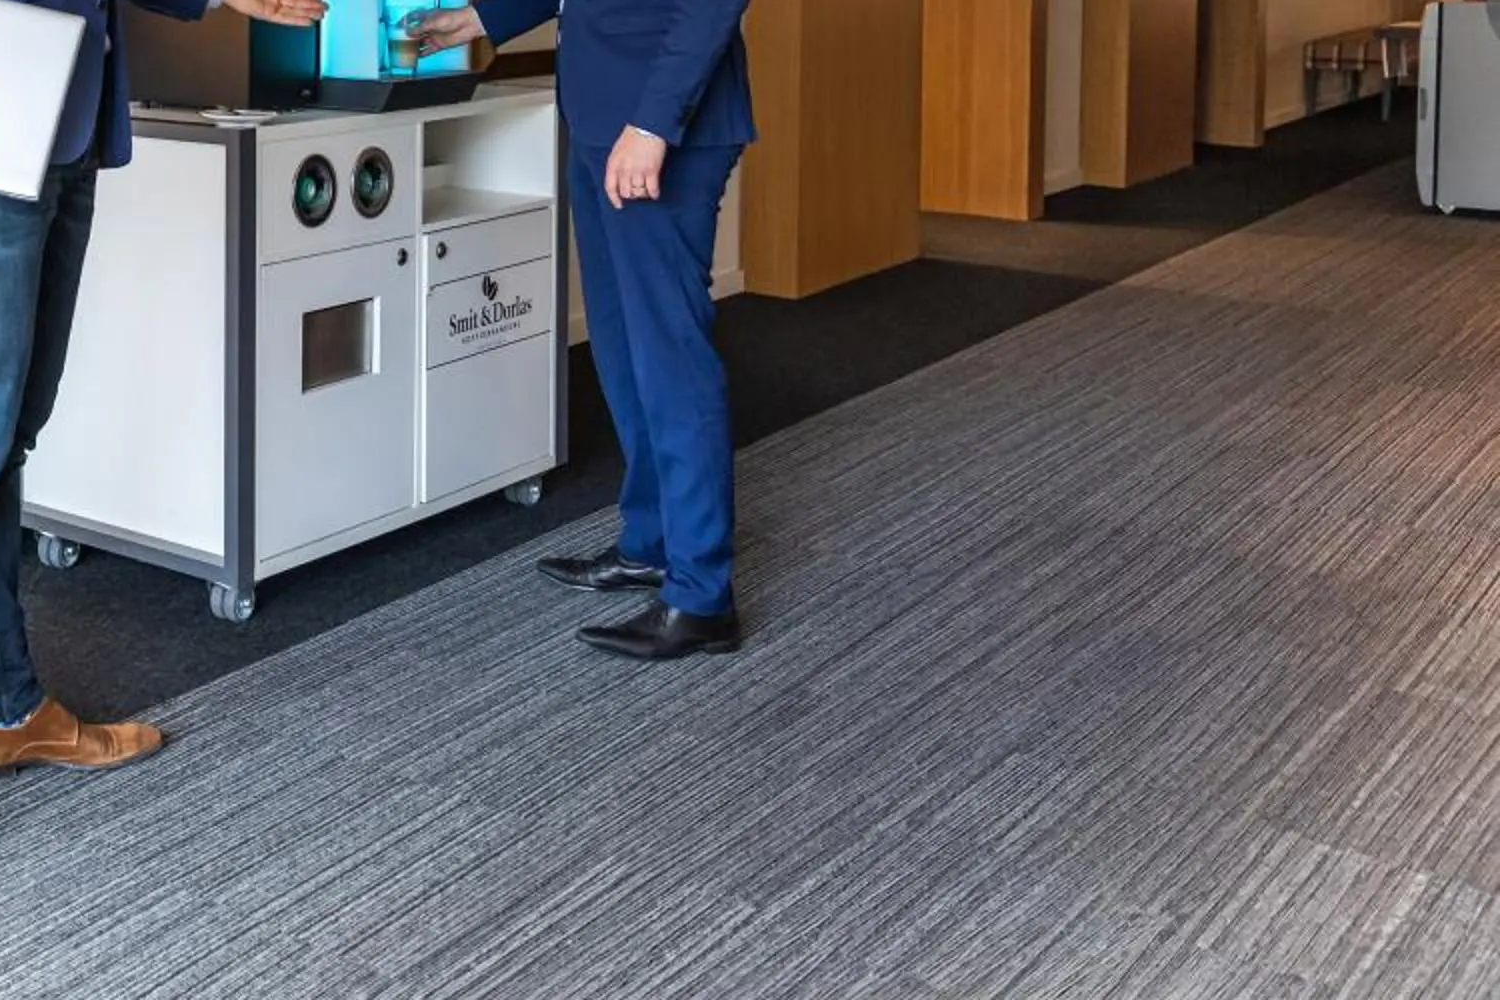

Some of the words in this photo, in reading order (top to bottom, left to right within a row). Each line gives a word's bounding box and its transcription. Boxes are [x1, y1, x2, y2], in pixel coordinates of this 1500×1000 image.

[449, 308, 478, 337] Smit
[480, 306, 492, 327] &
[493, 297, 532, 323] Dorlas
